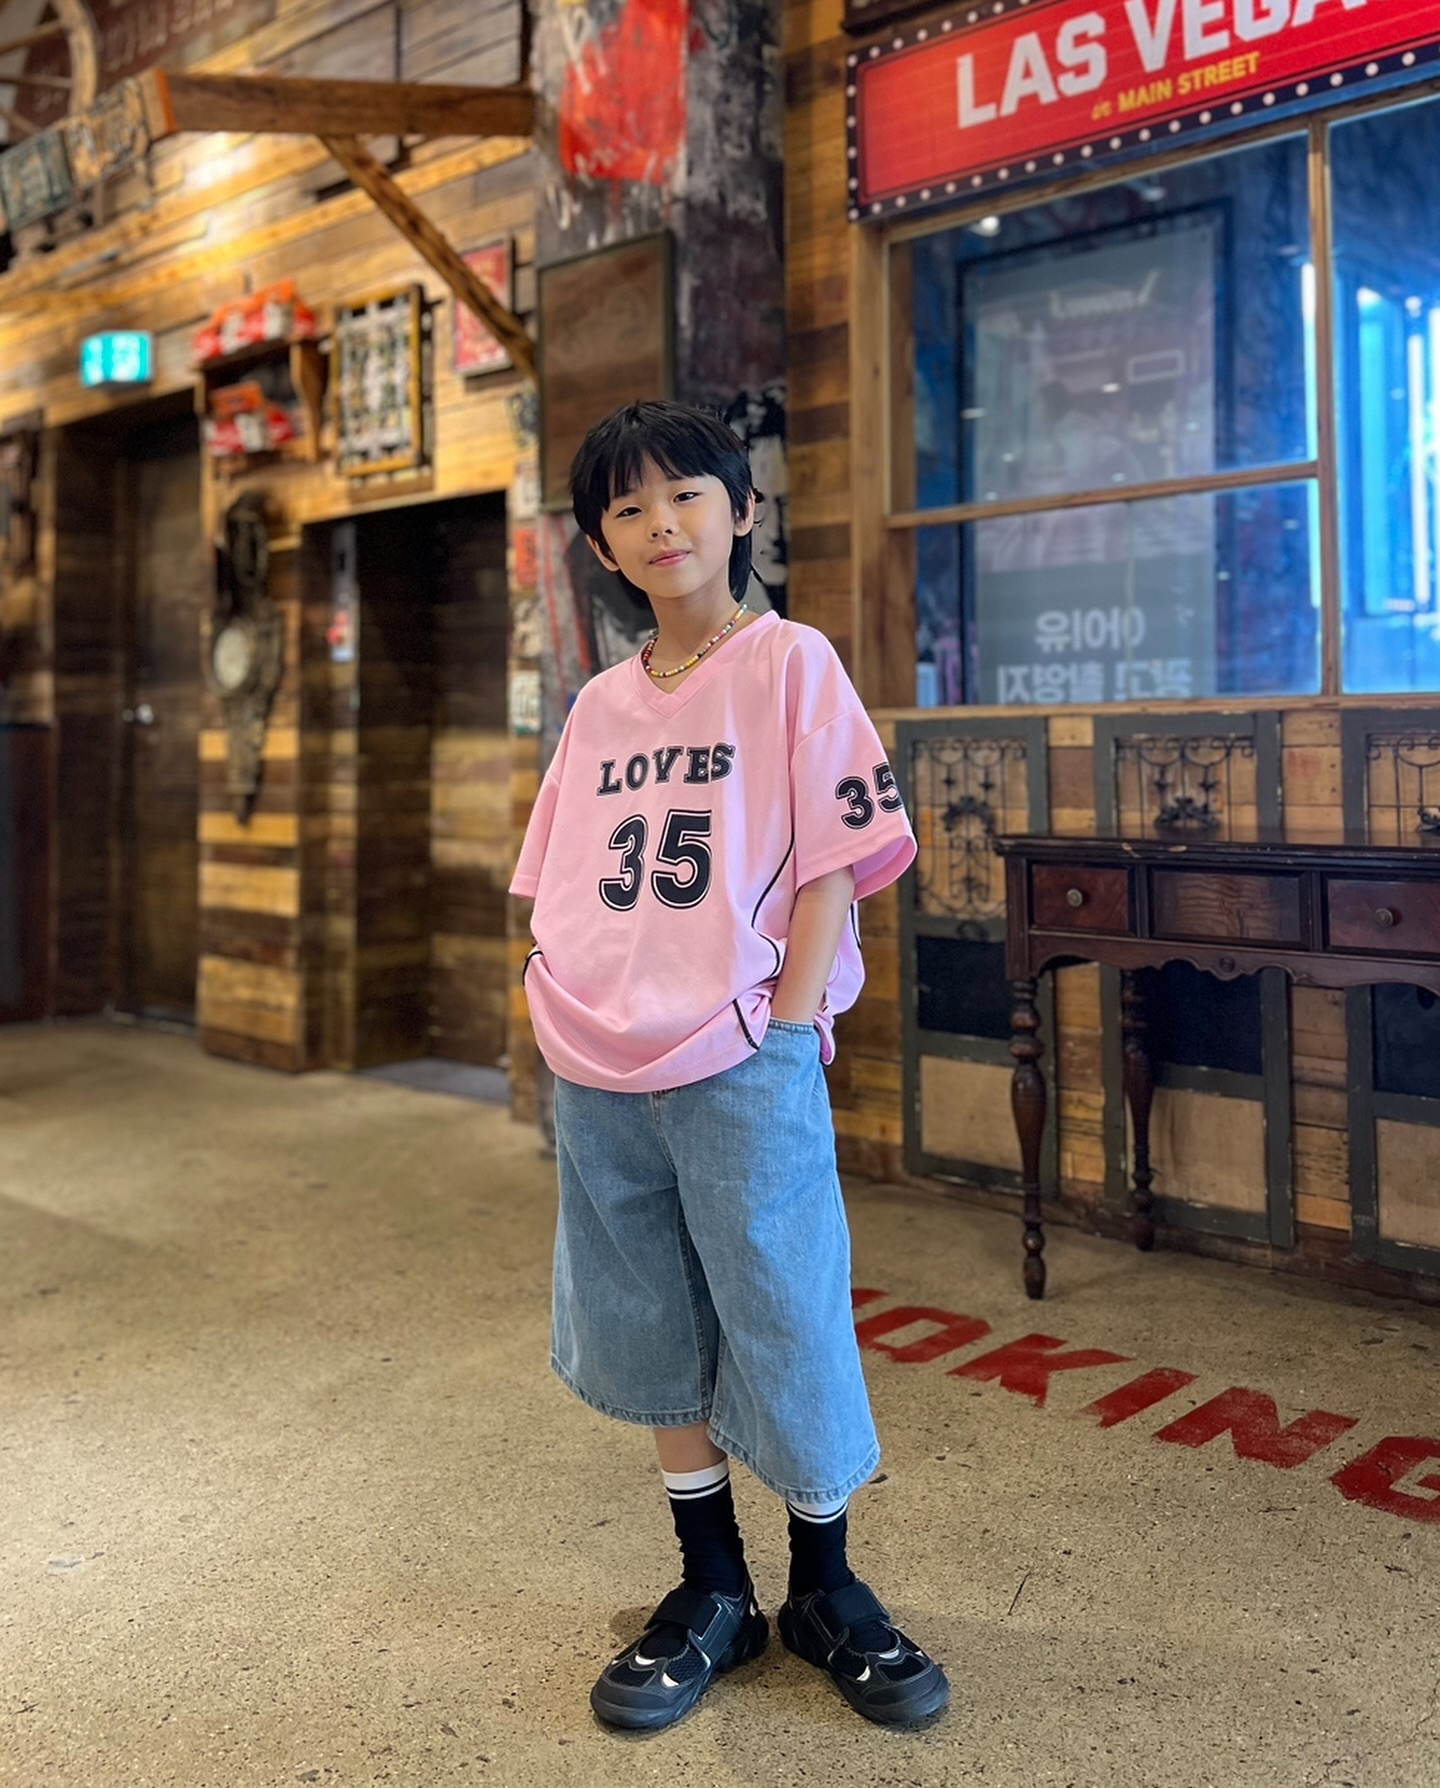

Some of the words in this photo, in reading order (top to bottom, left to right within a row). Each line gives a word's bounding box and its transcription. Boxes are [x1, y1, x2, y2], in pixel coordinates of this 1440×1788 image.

[957, 12, 1107, 129] LAS
[1118, 78, 1172, 113] MAIN
[1178, 51, 1260, 96] STREET
[597, 742, 736, 796] LOVES
[836, 763, 903, 829] 35
[599, 809, 712, 911] 35
[852, 1288, 1440, 1524] OKING
